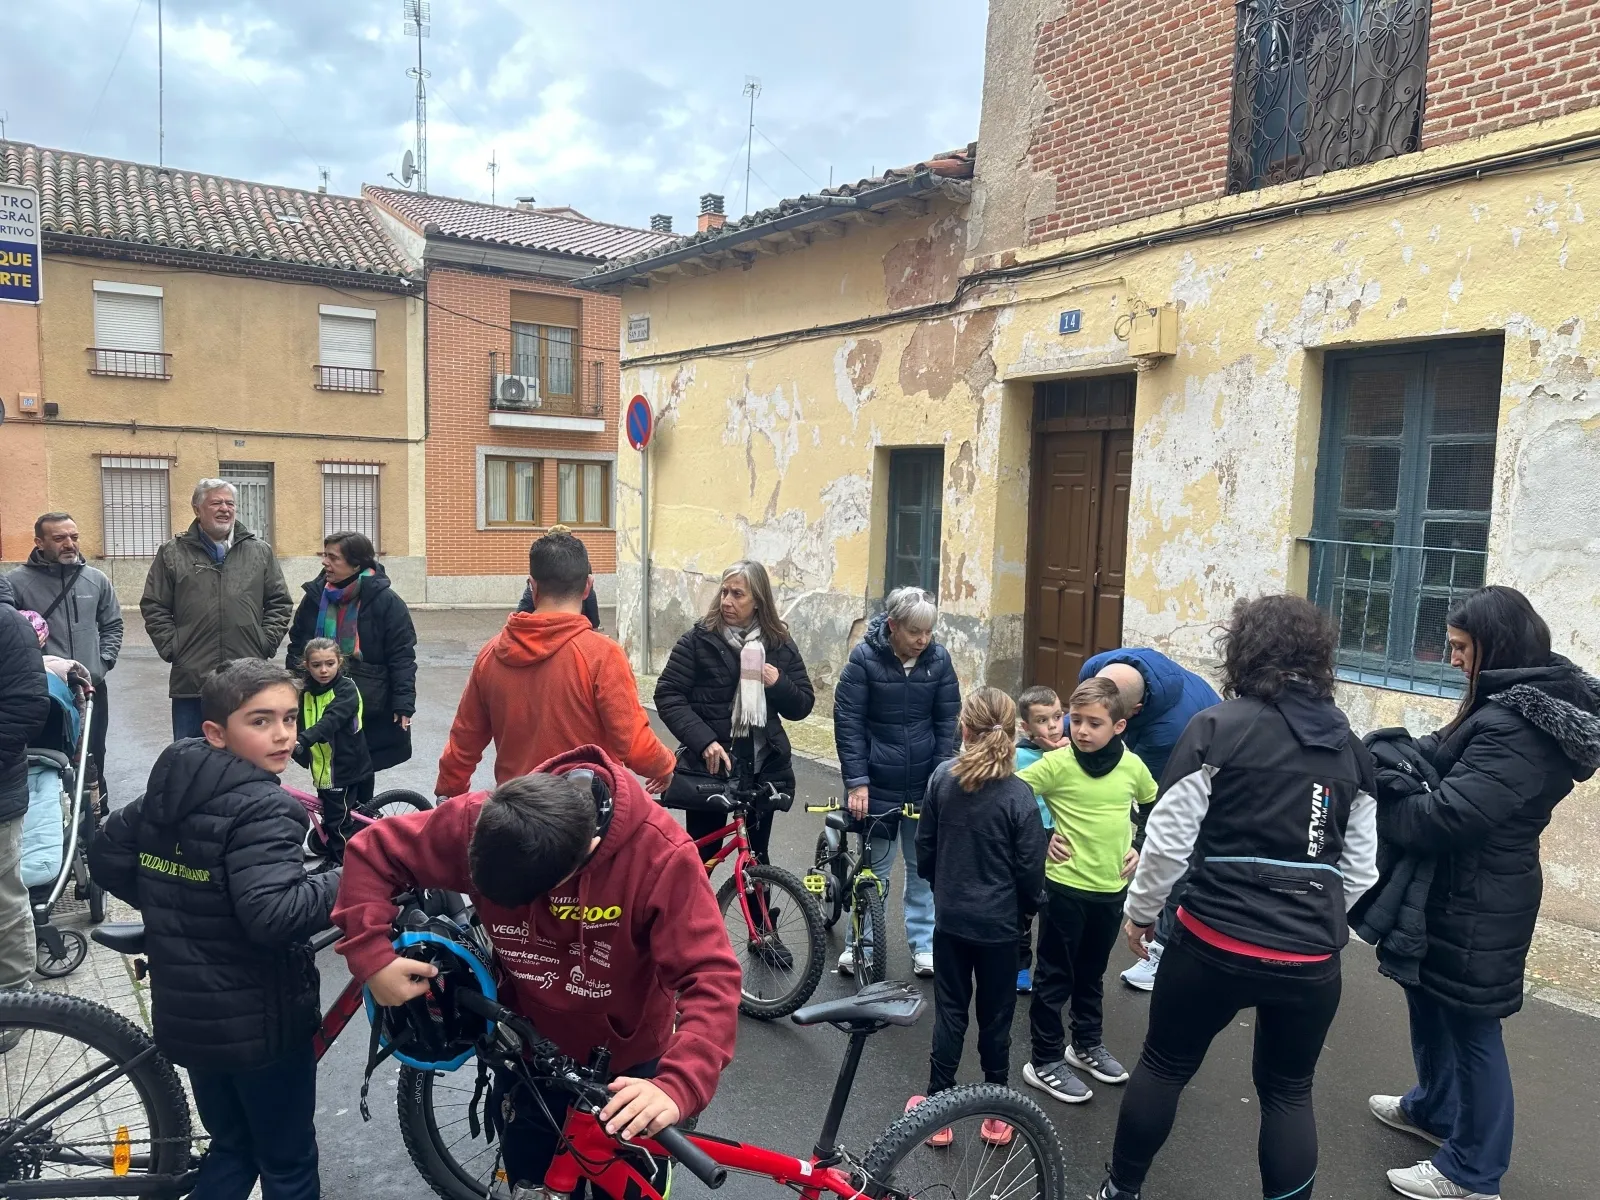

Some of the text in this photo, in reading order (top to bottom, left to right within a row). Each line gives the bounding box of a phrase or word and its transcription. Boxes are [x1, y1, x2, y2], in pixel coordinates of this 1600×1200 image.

[1, 195, 33, 209] TRO
[0, 226, 34, 237] RTIVO
[0, 251, 32, 267] QUE
[1063, 313, 1076, 329] 14
[1319, 807, 1328, 826] TEAM
[168, 861, 178, 876] DE
[550, 896, 581, 904] RIATLO
[496, 946, 560, 965] imarket.com
[565, 983, 612, 999] aparicio
[414, 1072, 424, 1104] COMP
[1046, 1153, 1058, 1182] BLACK
